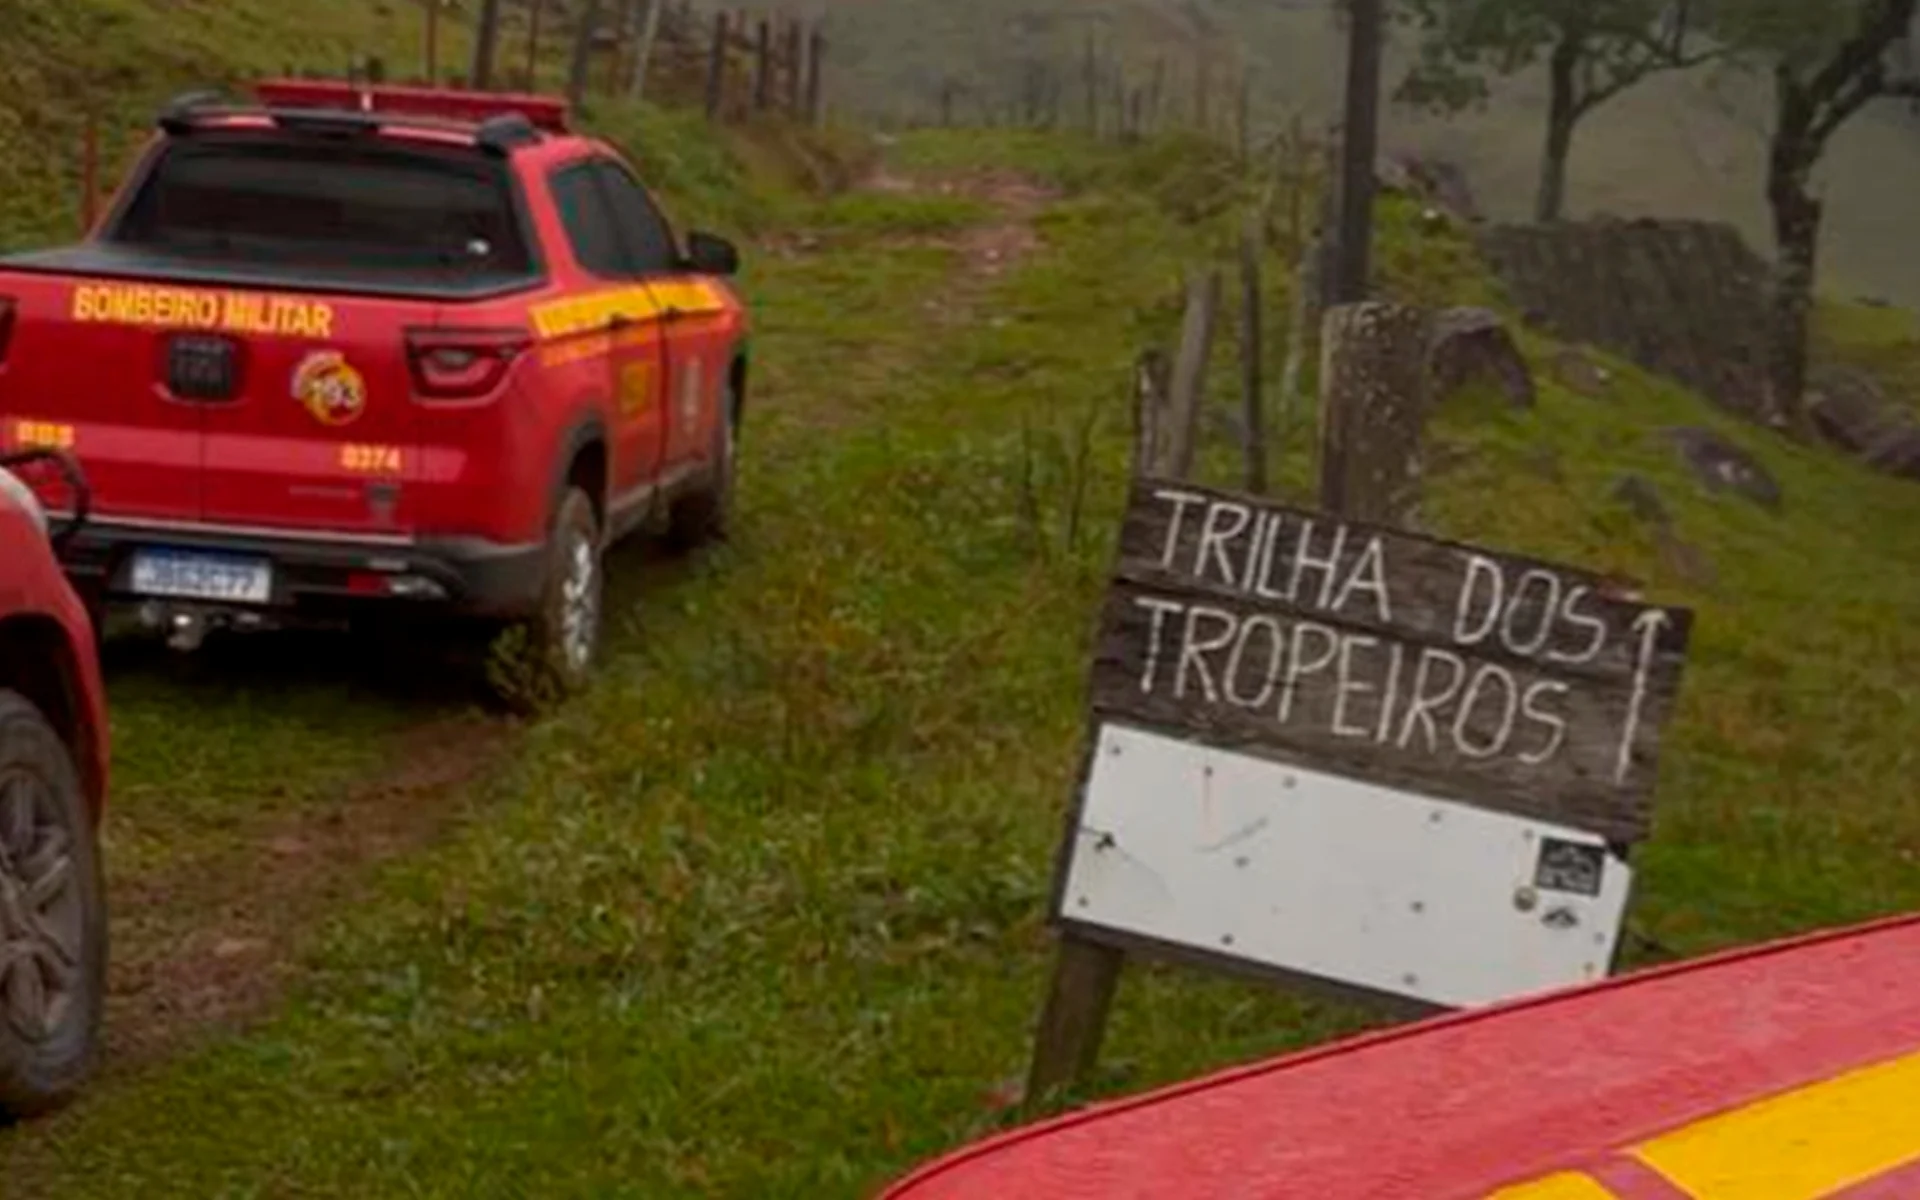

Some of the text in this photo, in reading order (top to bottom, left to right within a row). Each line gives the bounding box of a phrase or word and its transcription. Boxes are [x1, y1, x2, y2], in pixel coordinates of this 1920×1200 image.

[73, 286, 333, 338] BOMBEIRO MILITAR
[1153, 488, 1608, 664] TRILHA DOS
[1134, 597, 1570, 765] TROPEIROS
